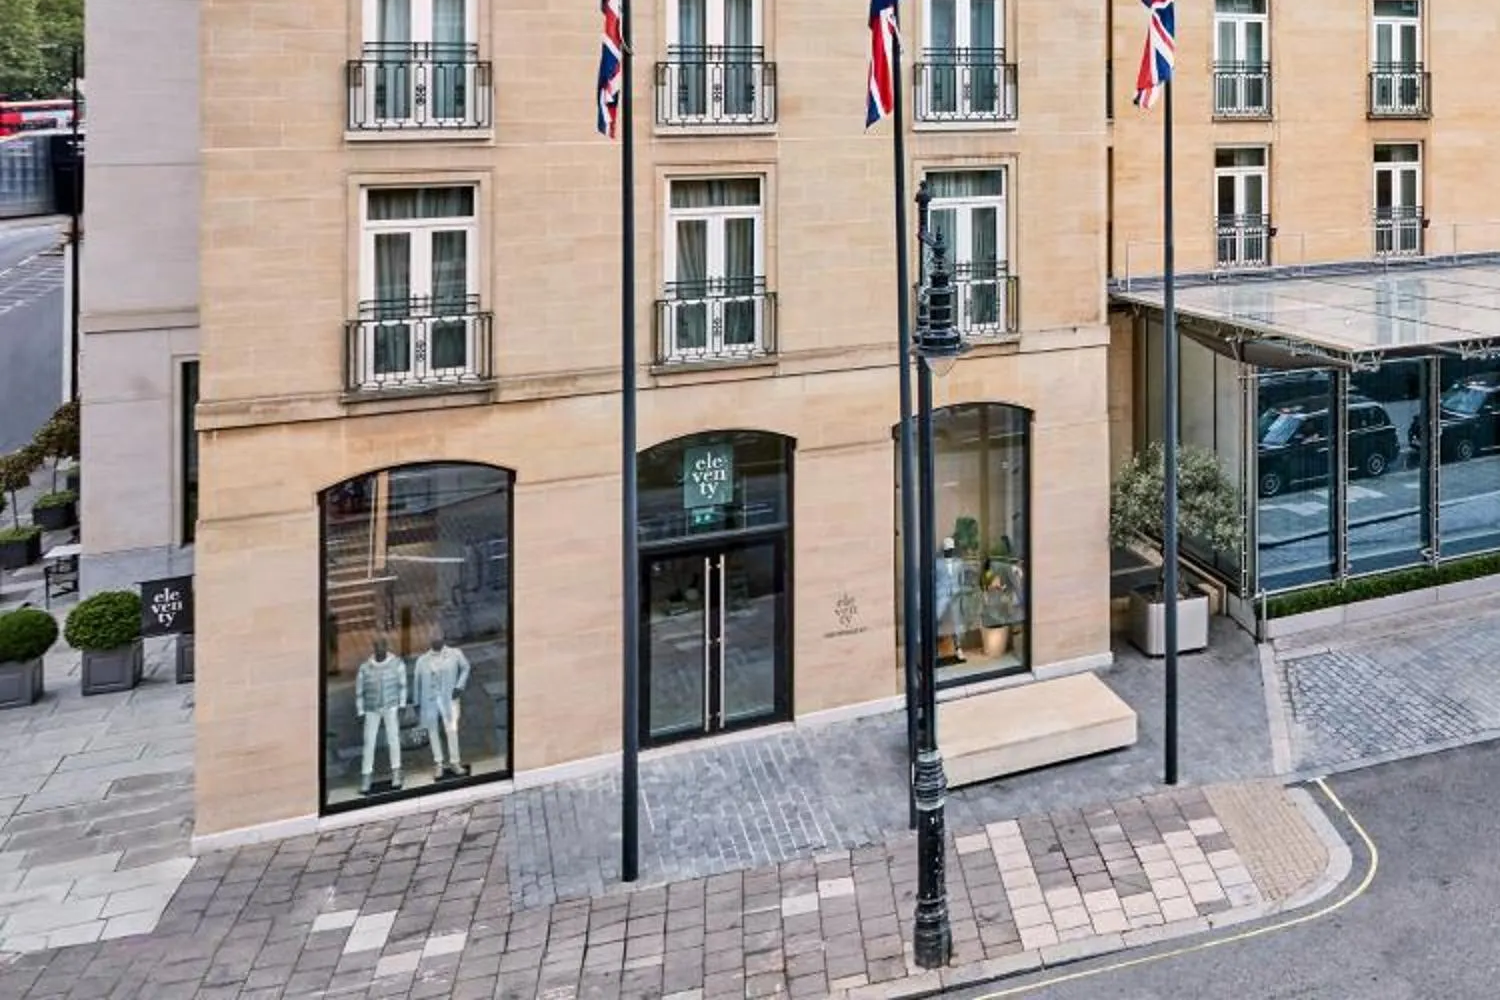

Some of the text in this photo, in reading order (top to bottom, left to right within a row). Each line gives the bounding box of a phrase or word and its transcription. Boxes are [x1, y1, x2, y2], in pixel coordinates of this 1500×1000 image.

[695, 450, 723, 471] ele
[692, 469, 726, 483] ven
[700, 481, 719, 499] ty
[153, 587, 181, 603] ele
[151, 600, 183, 614] ven
[158, 612, 177, 627] ty
